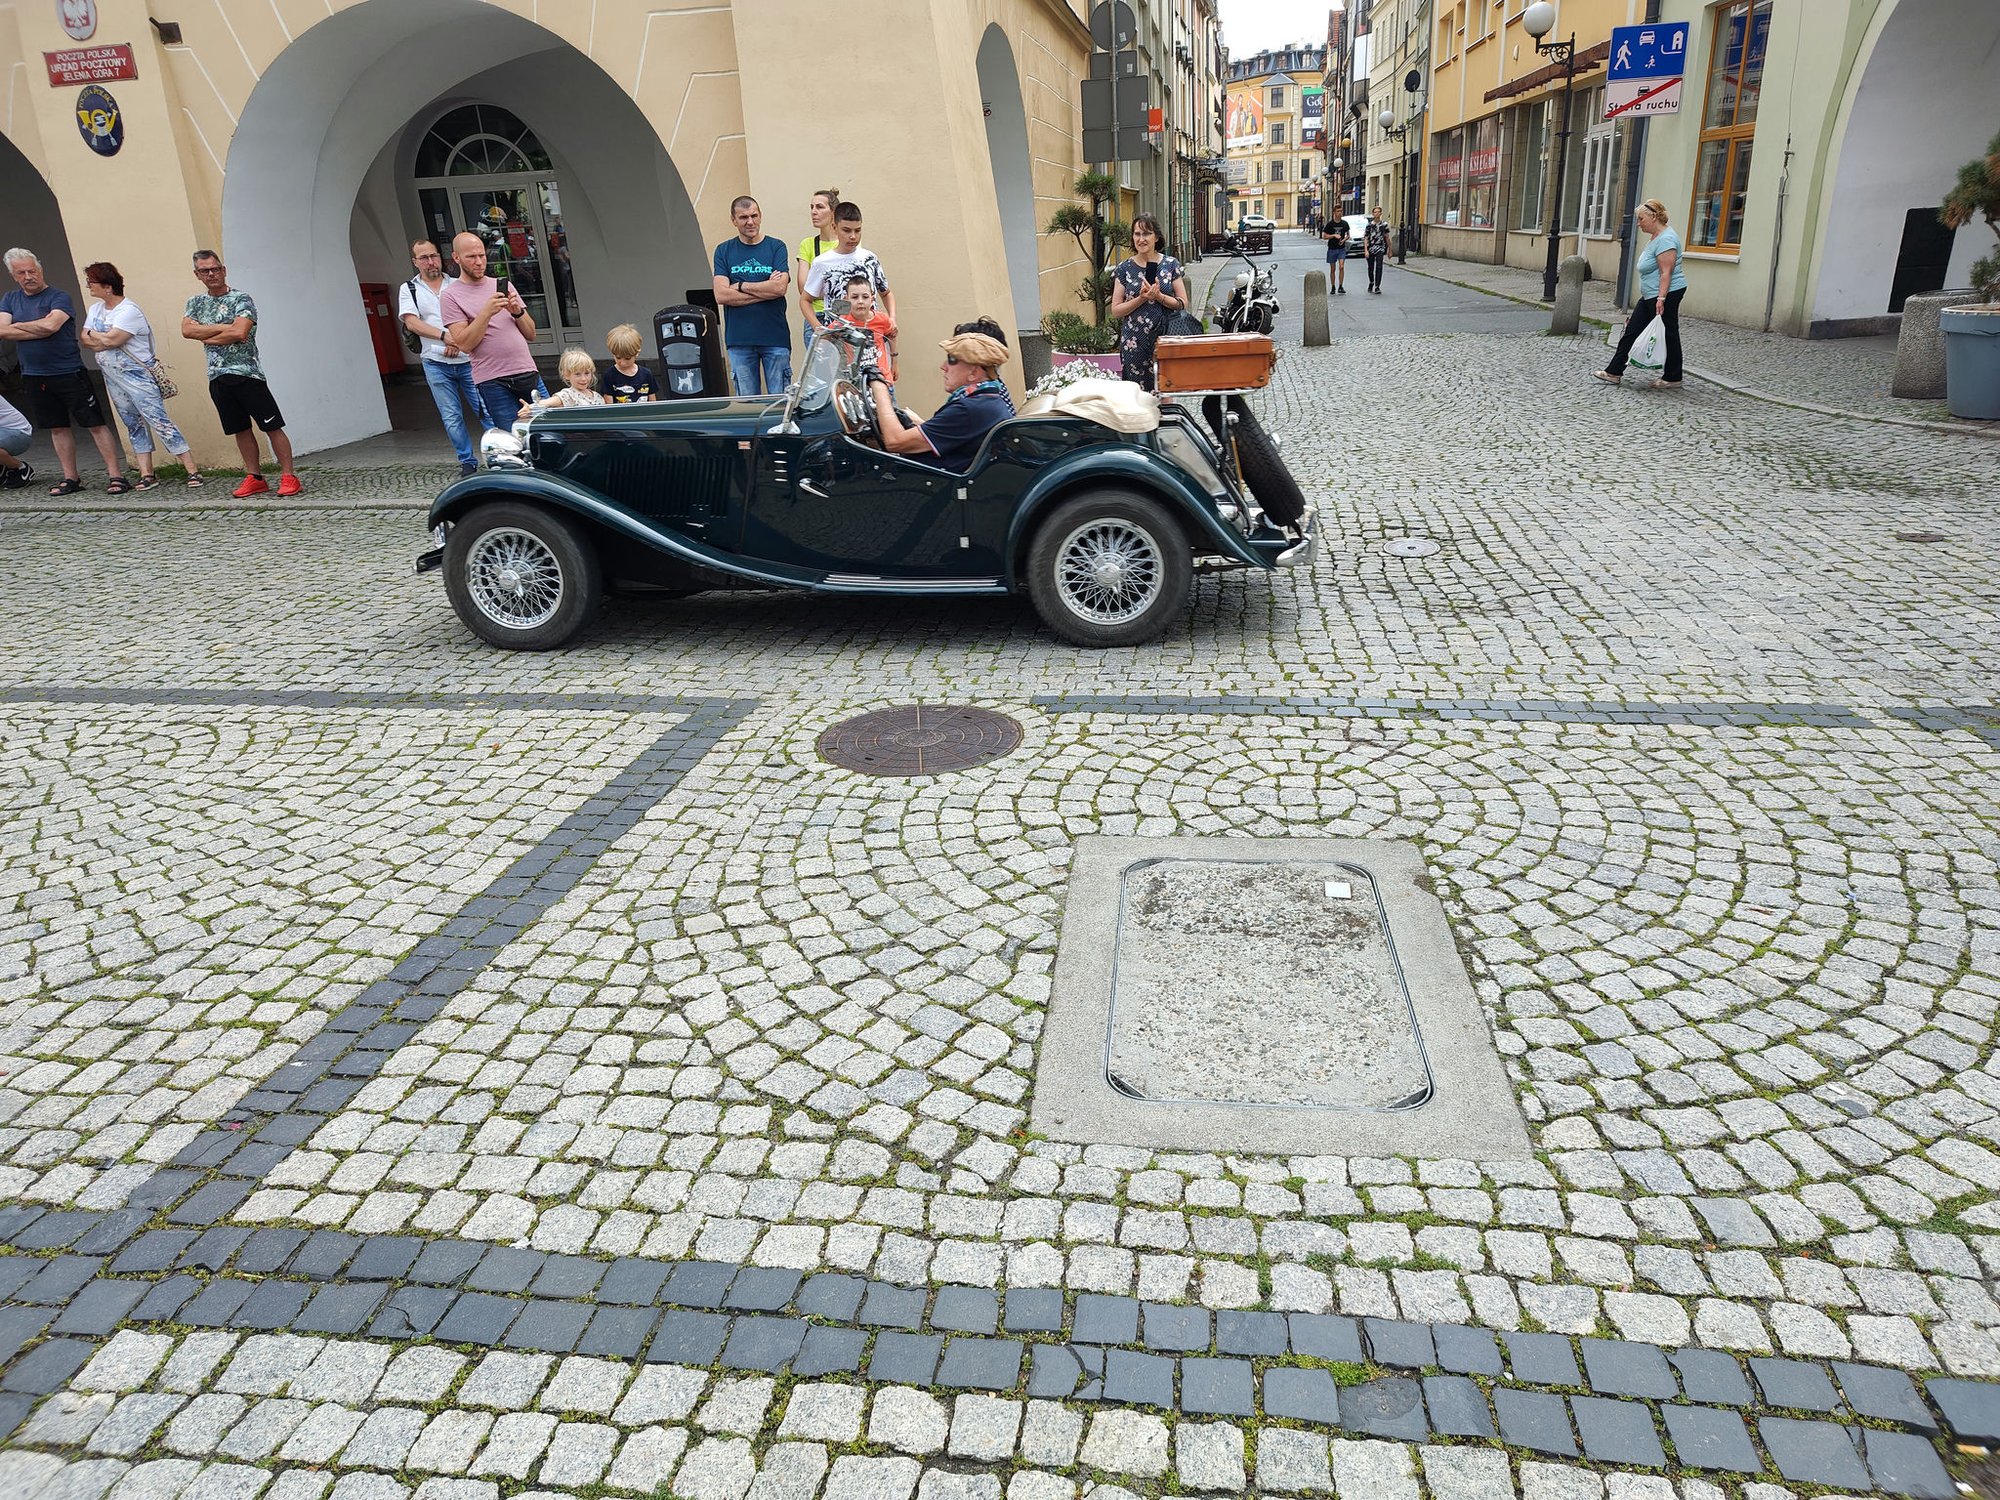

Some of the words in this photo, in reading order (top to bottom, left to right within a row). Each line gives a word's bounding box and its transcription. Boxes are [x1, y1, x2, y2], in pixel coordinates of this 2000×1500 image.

[57, 52, 85, 62] POCZTA
[87, 49, 117, 58] POLSKA
[81, 58, 126, 69] POCZTOWY
[63, 71, 92, 81] JELENIA
[114, 67, 120, 77] 7
[1607, 102, 1641, 112] Stra
[1646, 99, 1678, 109] ruchu
[731, 265, 773, 273] EXPLORE
